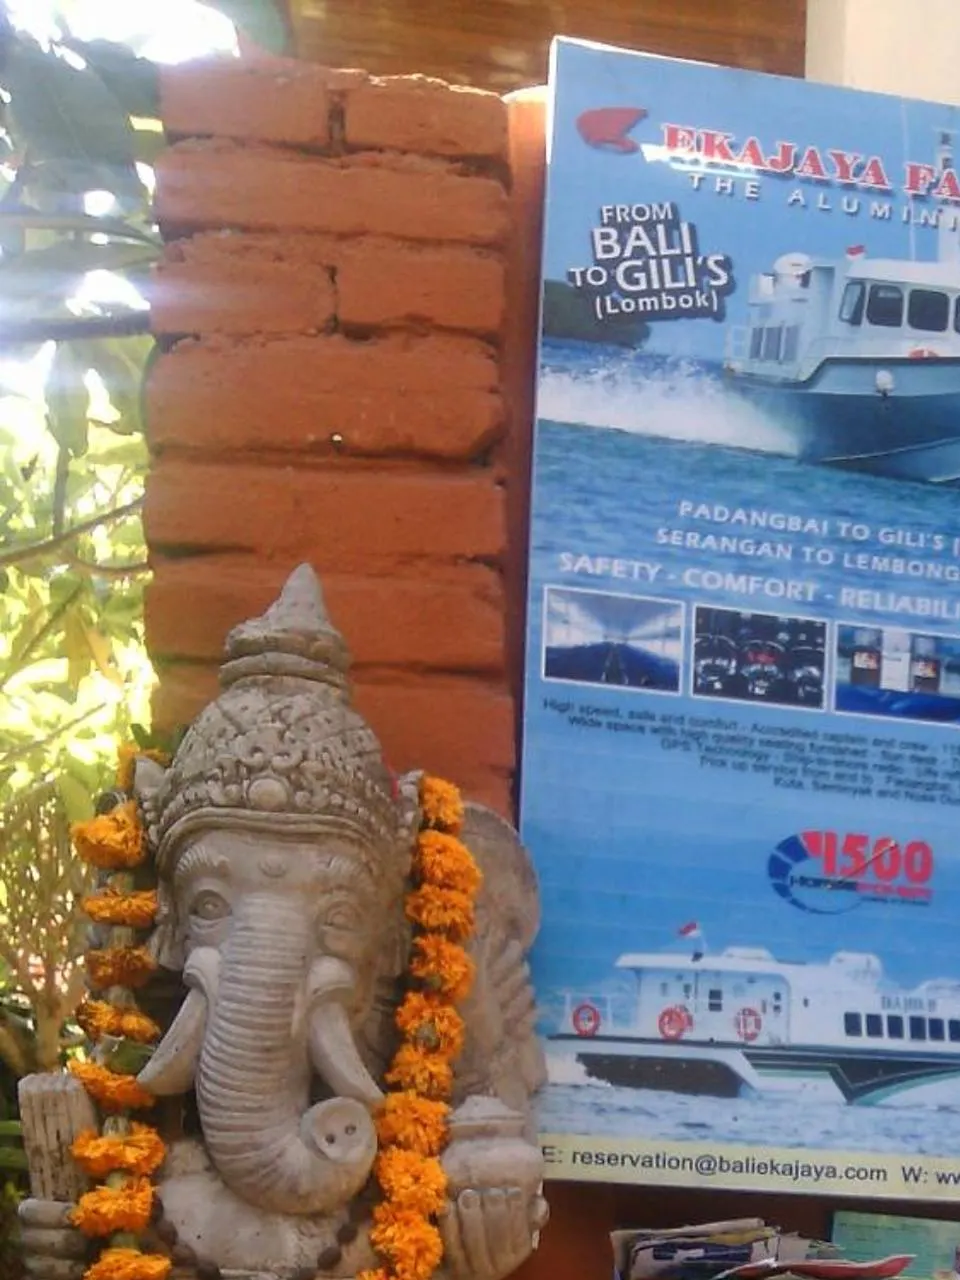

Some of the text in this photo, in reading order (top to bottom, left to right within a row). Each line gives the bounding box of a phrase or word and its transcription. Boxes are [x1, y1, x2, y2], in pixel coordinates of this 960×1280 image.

[663, 124, 890, 189] EKAJAYA
[689, 173, 761, 200] THE
[600, 202, 673, 226] FROM
[592, 221, 692, 260] BALI
[568, 255, 729, 292] TO GILI'S
[595, 290, 720, 319] (Lombok)
[679, 500, 829, 537] PADANGBAI
[836, 521, 870, 541] TO
[877, 527, 945, 550] GILI'S
[656, 526, 793, 561] SERANGAN
[801, 546, 835, 566] TO
[558, 550, 663, 583] SAFETY
[682, 567, 820, 602] COMFORT
[572, 1148, 888, 1183] reservation@baliekajaya.com
[901, 1166, 928, 1184] W:
